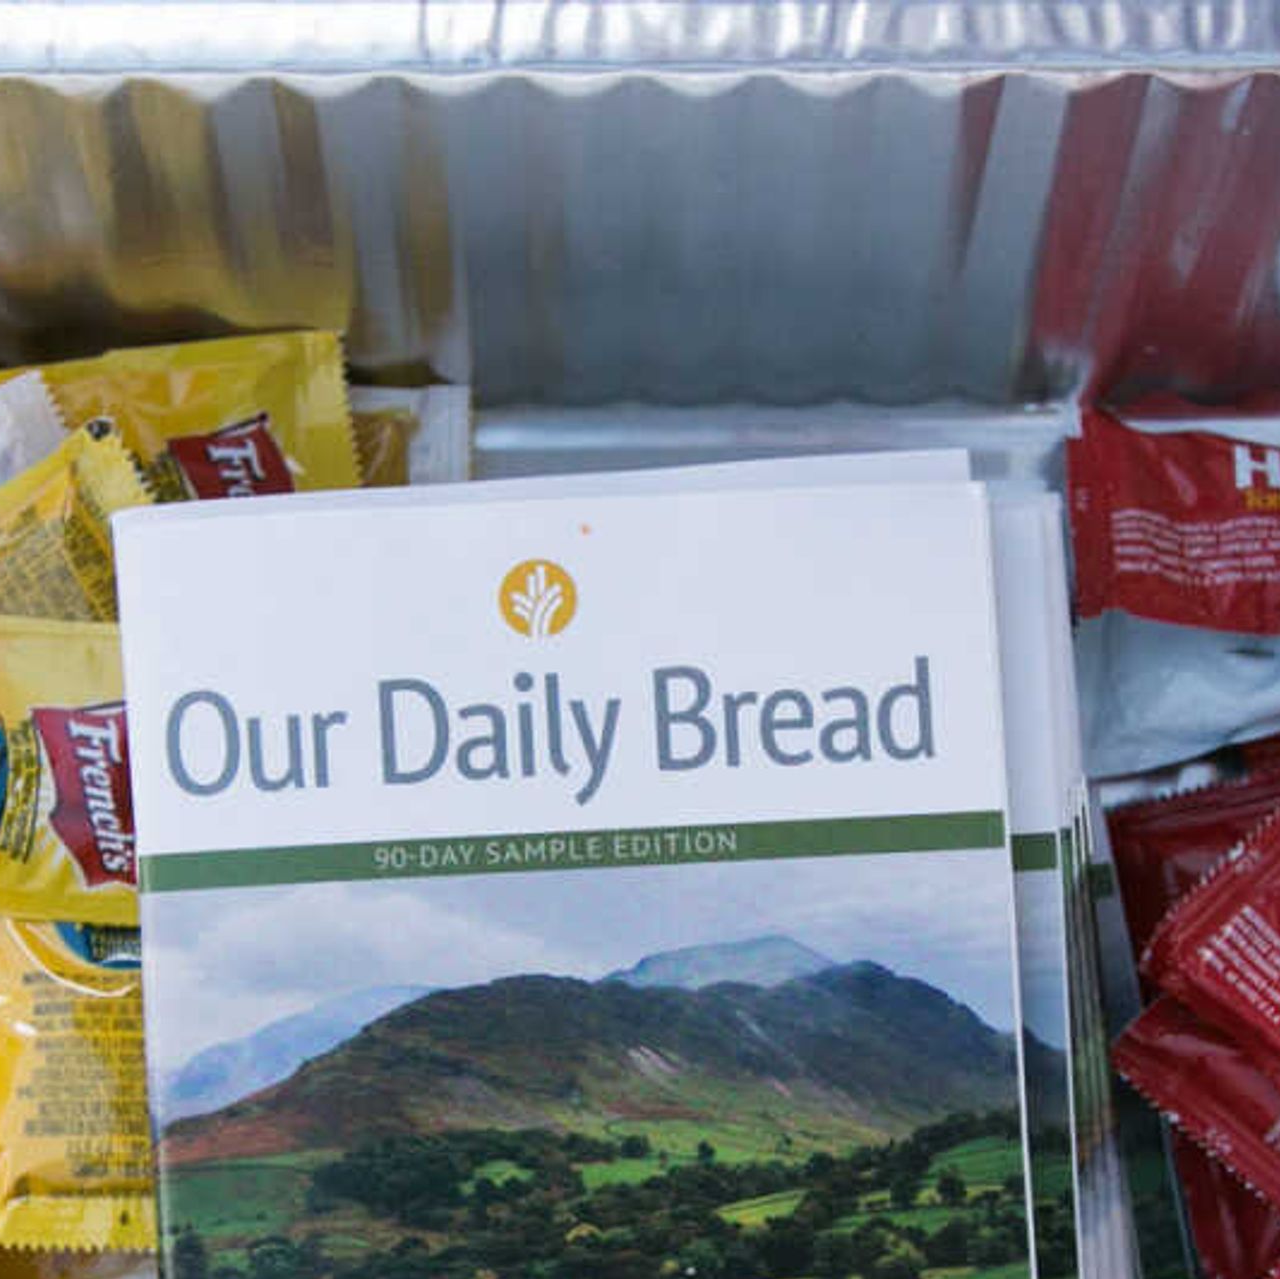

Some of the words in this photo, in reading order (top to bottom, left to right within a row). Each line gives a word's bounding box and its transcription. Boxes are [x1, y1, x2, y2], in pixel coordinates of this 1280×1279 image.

[68, 718, 135, 876] French's
[165, 687, 345, 796] Our
[379, 671, 620, 806] Daily
[654, 656, 935, 772] Bread
[374, 842, 473, 870] 90-DAY
[486, 835, 603, 865] SAMPLE
[613, 829, 738, 859] EDITION
